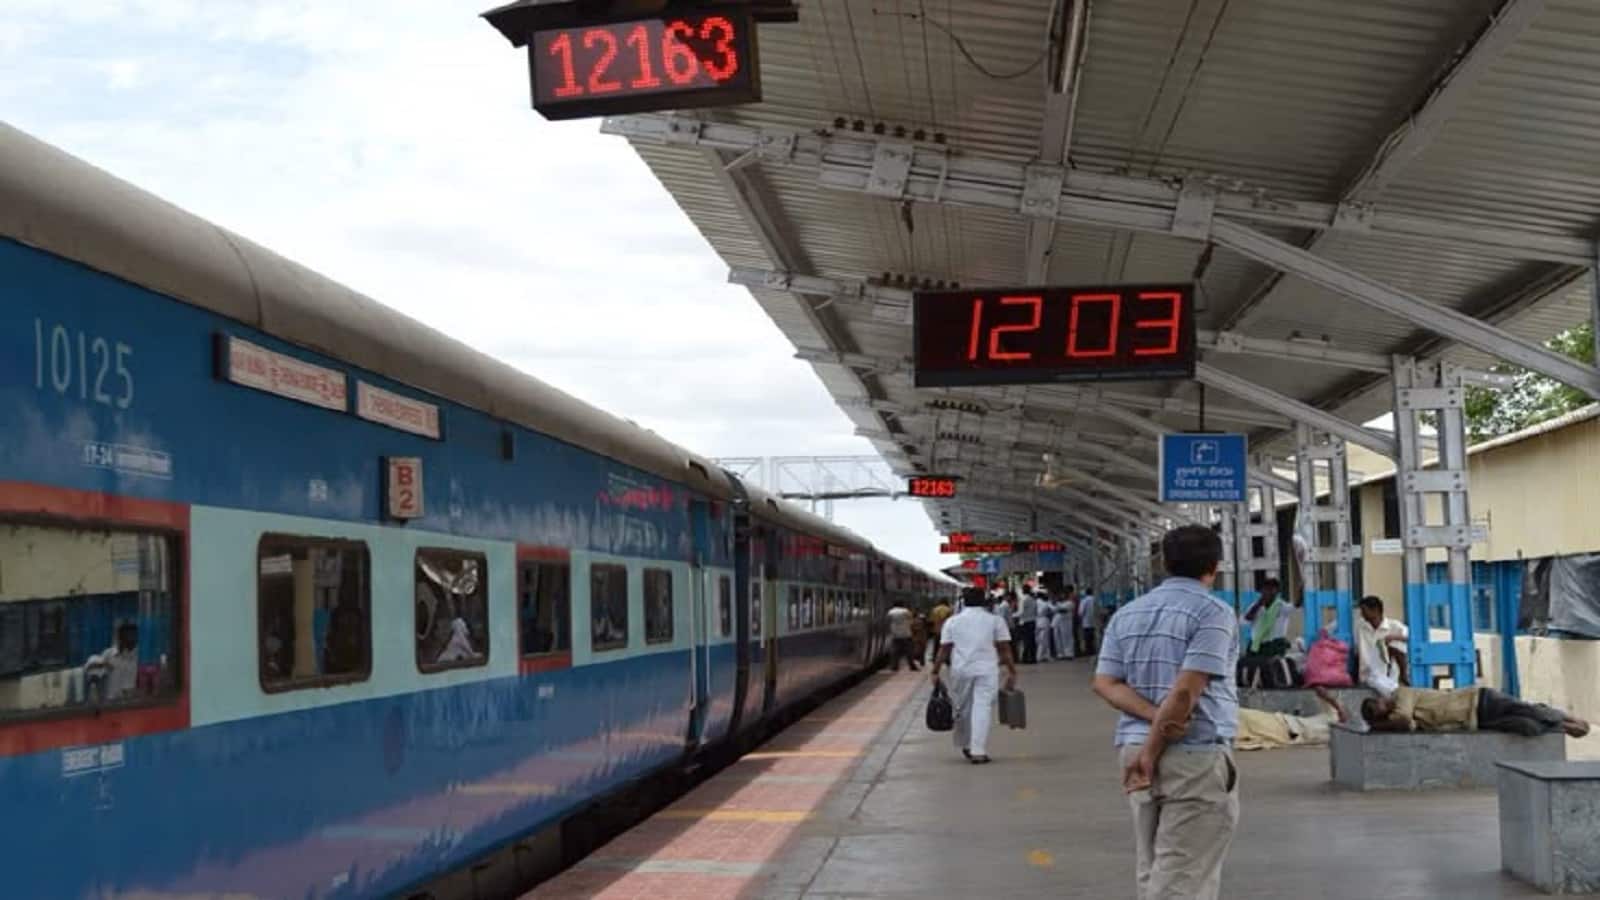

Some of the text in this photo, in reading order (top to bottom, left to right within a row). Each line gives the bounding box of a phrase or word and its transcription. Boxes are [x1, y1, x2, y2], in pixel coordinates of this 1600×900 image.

[549, 16, 738, 96] 12163
[35, 318, 134, 409] 10125
[912, 479, 953, 496] 12163
